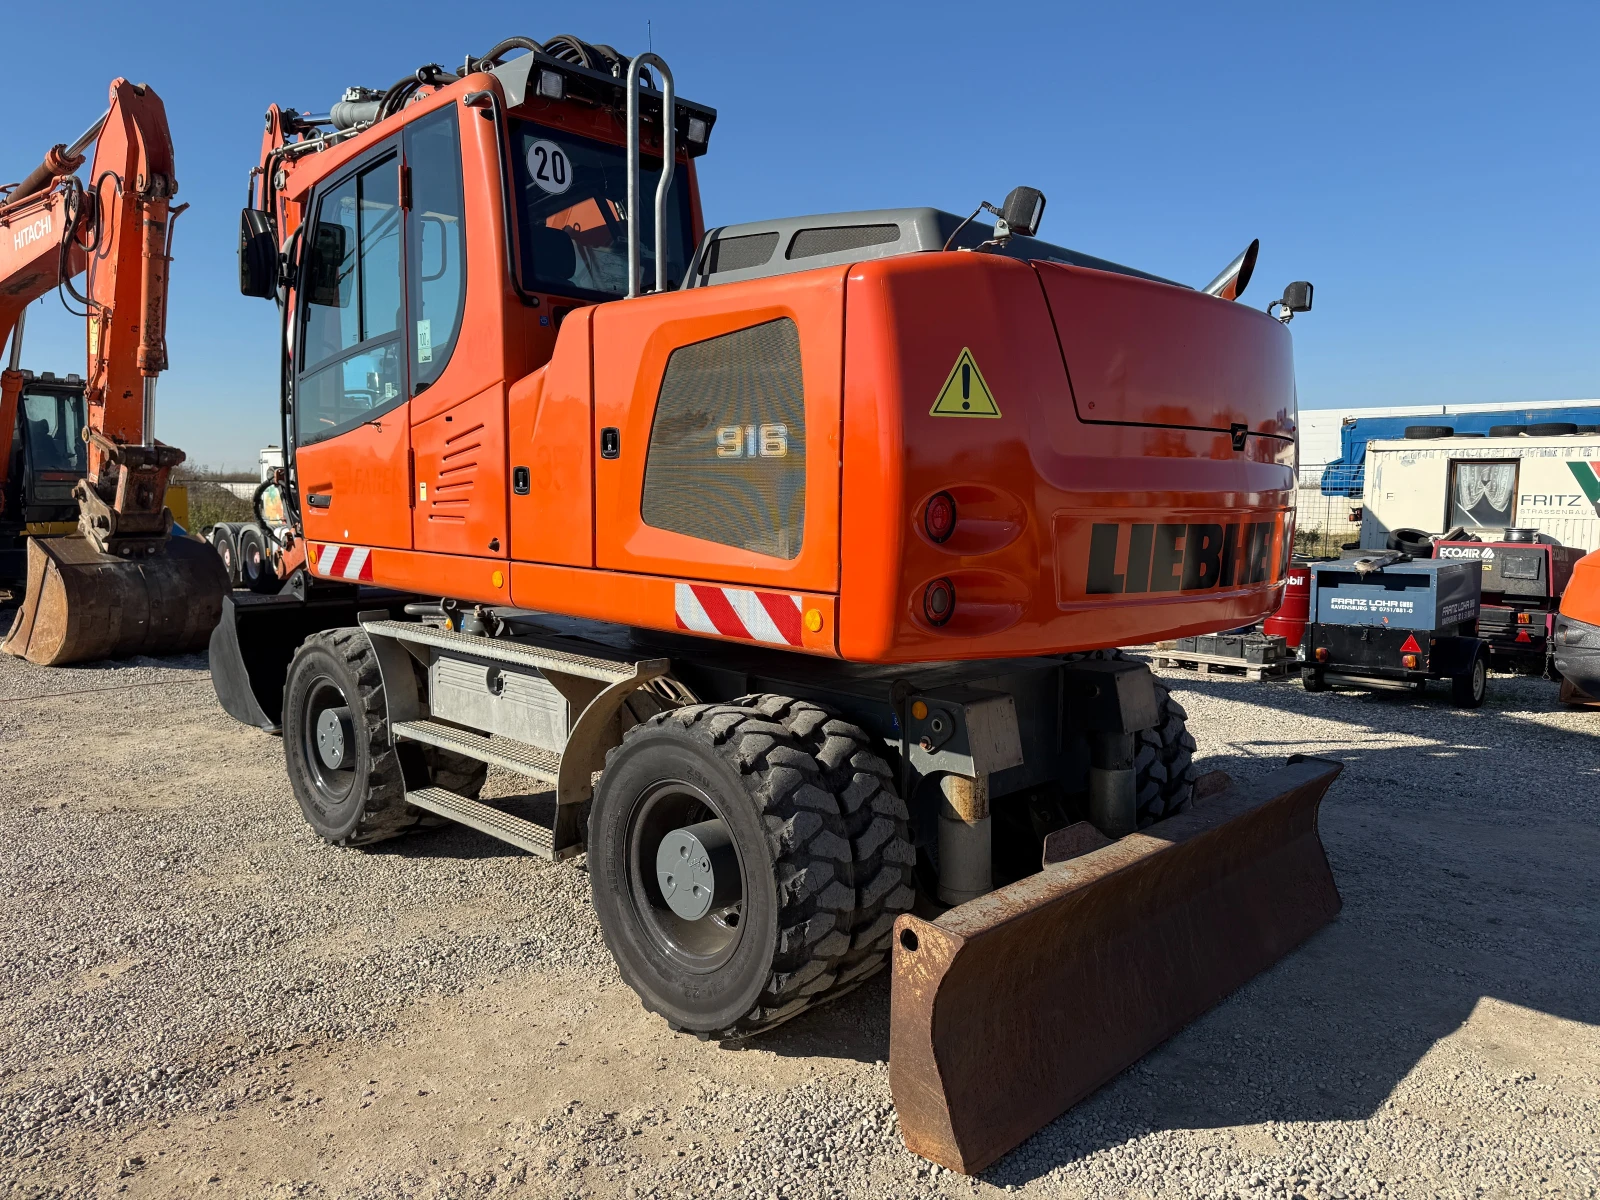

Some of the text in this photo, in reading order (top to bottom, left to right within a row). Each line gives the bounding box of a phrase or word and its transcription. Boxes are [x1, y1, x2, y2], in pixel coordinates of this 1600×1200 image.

[535, 146, 566, 185] 20
[13, 215, 52, 251] HITACHI
[716, 423, 788, 458] 916
[1520, 494, 1582, 507] FRITZ
[1440, 547, 1480, 559] ECOAIR
[1331, 597, 1368, 605] FRANZ
[1369, 599, 1399, 607] LOHR
